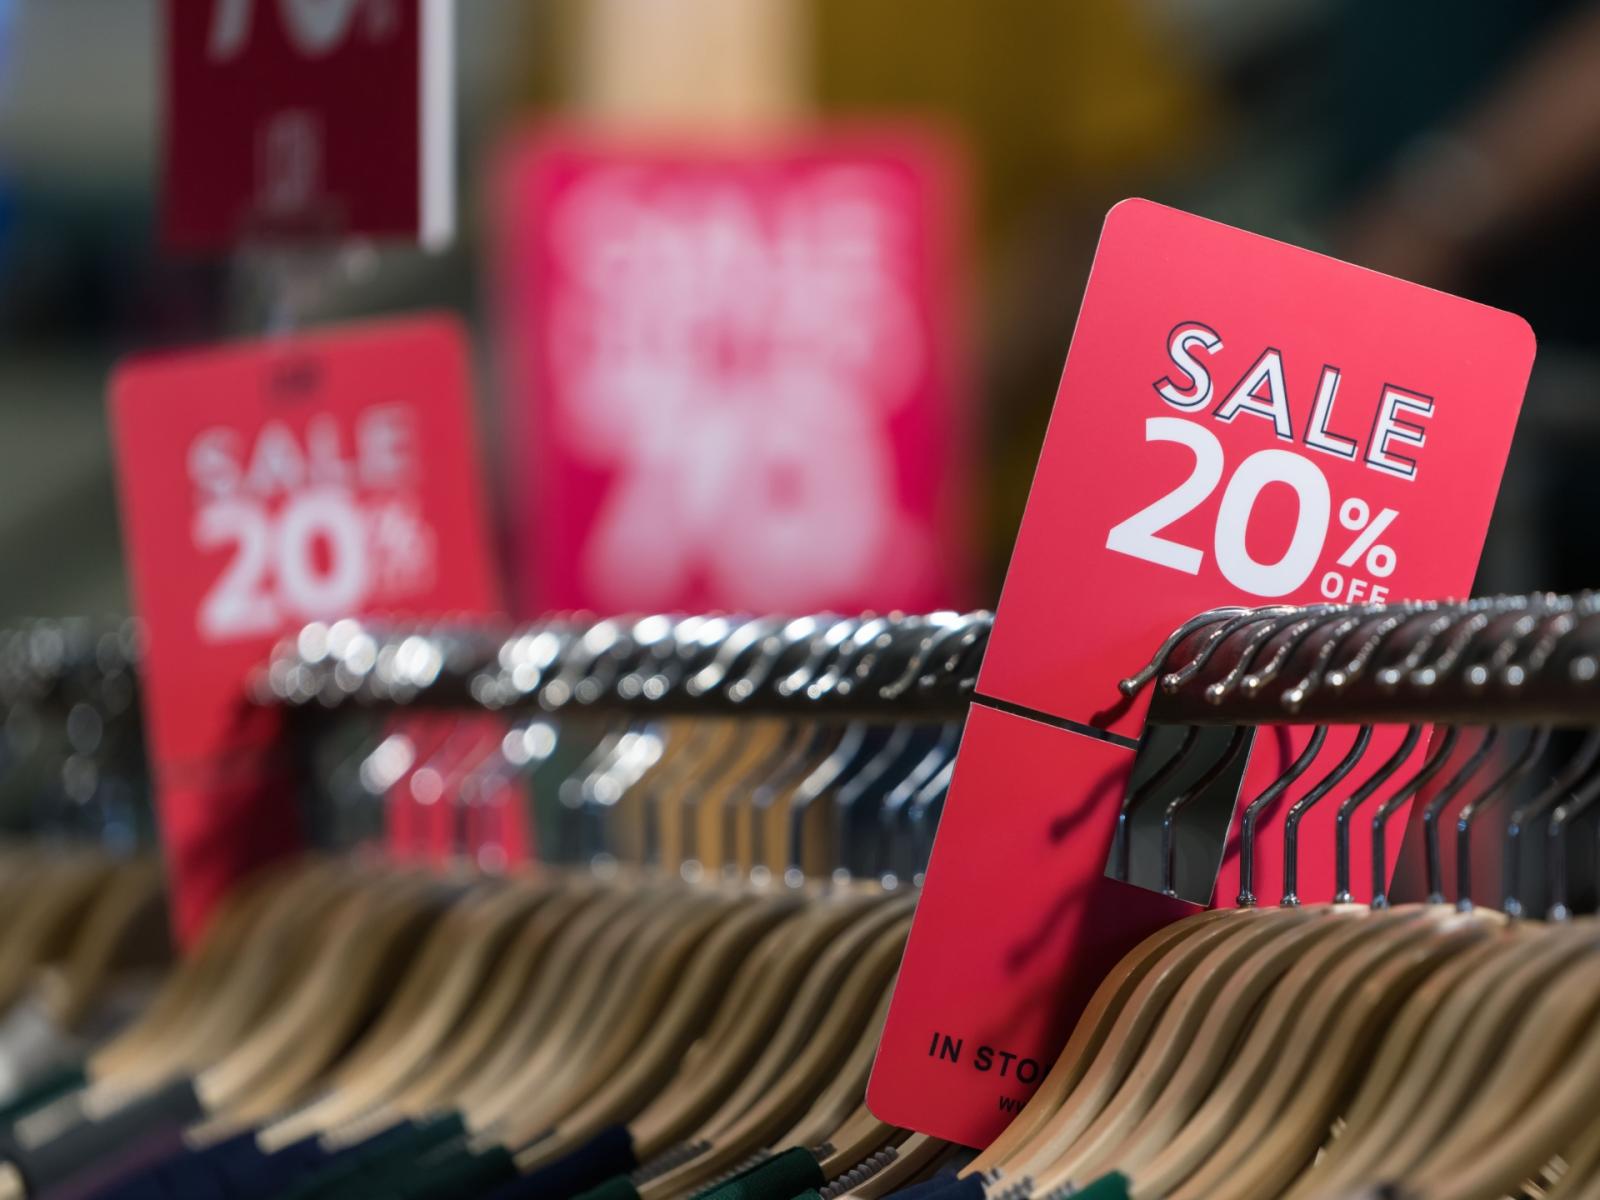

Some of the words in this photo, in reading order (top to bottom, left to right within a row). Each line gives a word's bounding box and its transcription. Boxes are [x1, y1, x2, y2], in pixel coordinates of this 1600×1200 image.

[1152, 321, 1435, 482] SALE
[187, 403, 416, 500] SALE
[1320, 571, 1389, 605] OFF
[928, 1032, 963, 1063] IN
[973, 1046, 1051, 1084] STO
